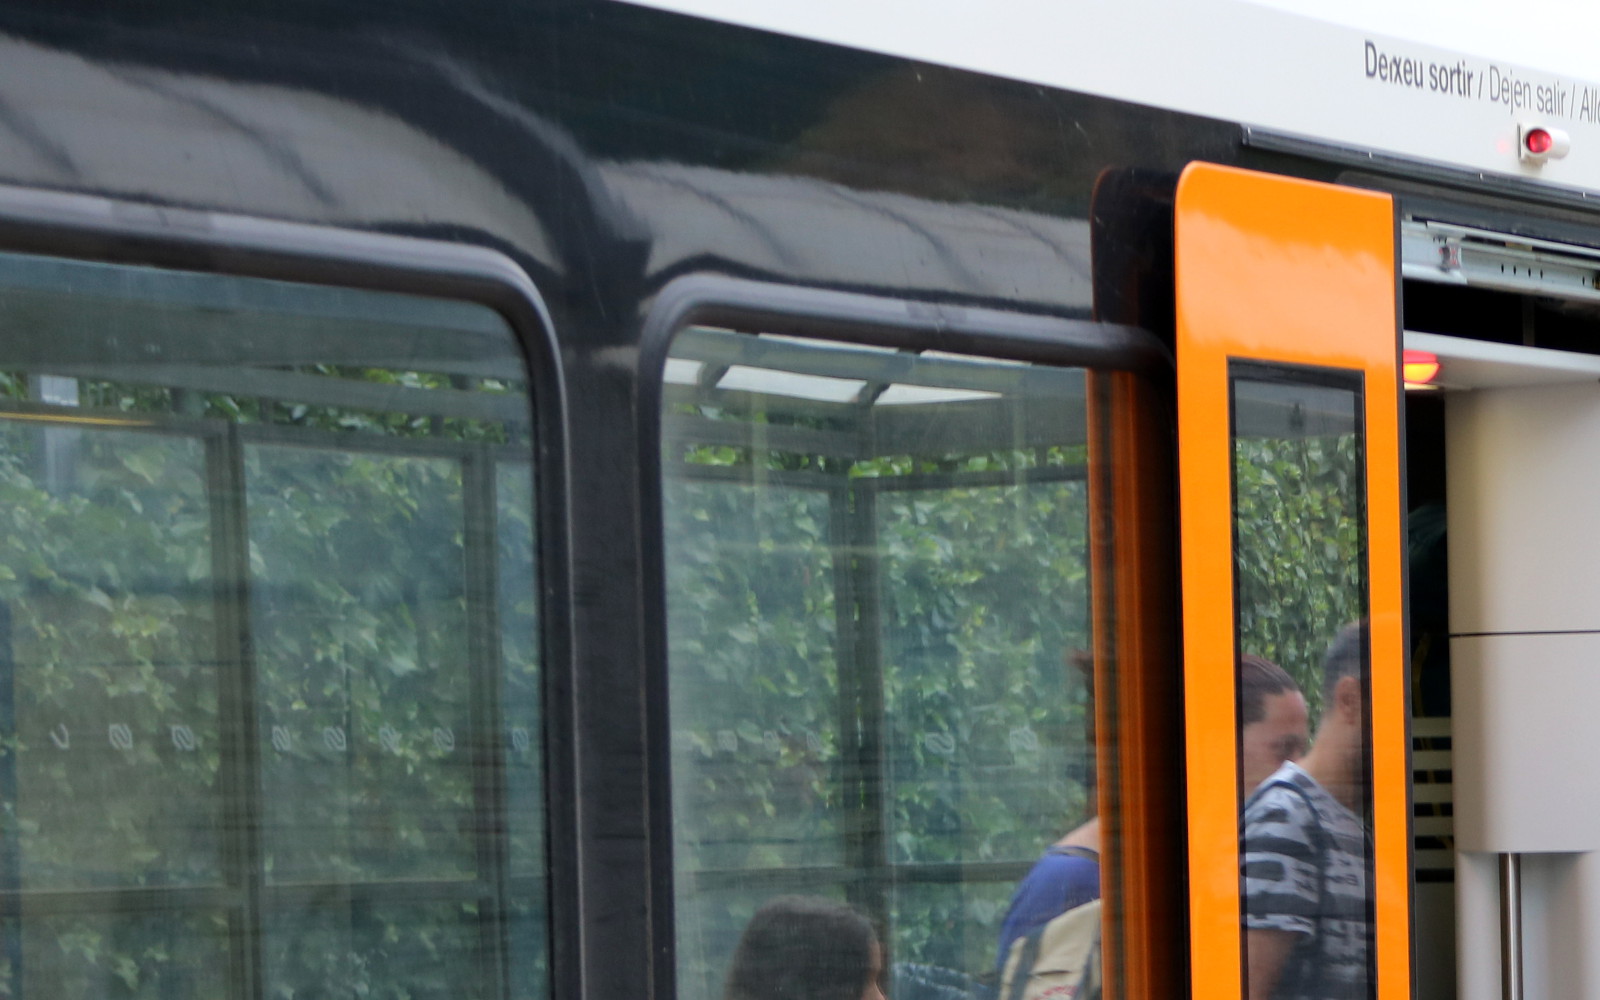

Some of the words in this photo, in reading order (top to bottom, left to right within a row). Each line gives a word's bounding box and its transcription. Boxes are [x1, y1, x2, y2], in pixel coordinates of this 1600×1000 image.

[1365, 39, 1424, 89] Deixeu
[1429, 59, 1474, 99] sortir
[1489, 64, 1532, 116] Dejen
[1536, 80, 1566, 118] salir
